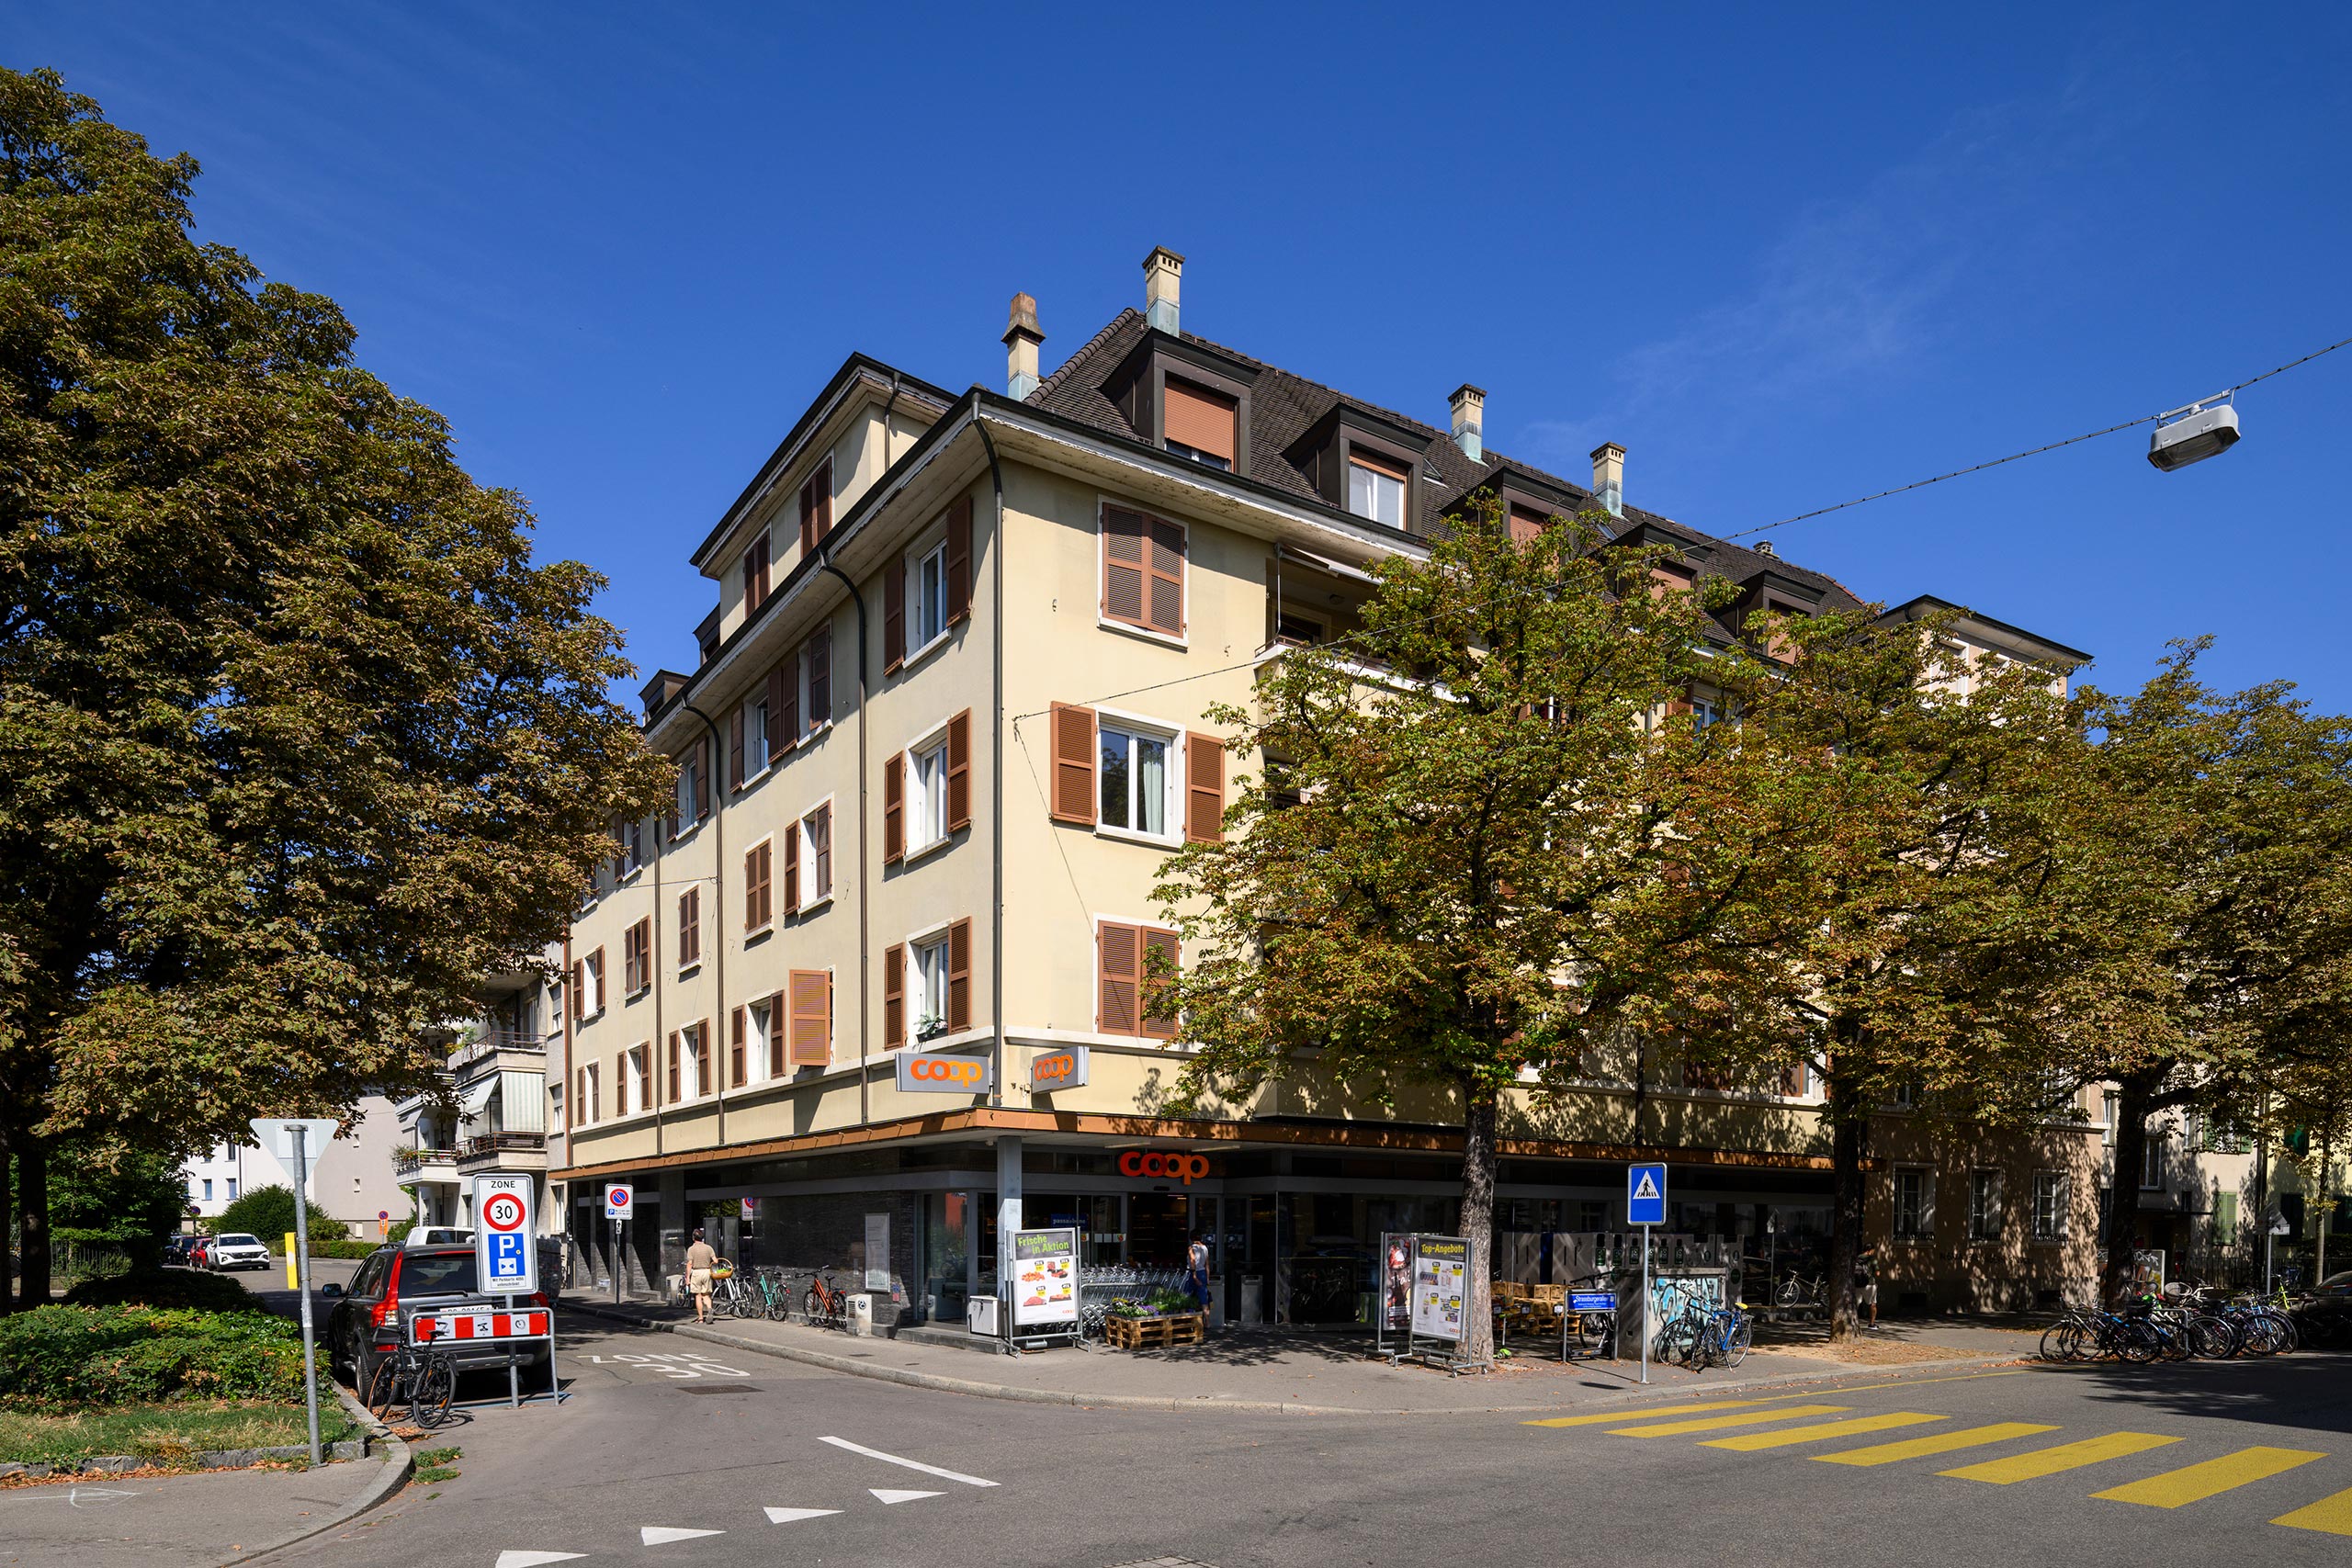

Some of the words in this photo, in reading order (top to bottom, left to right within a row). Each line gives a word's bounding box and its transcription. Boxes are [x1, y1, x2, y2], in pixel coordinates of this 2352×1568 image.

[910, 1059, 983, 1088] coop
[1035, 1055, 1073, 1082] coop
[1119, 1151, 1209, 1186] coop
[491, 1180, 515, 1189] ZONE
[495, 1205, 513, 1220] 30
[499, 1235, 514, 1258] P
[1017, 1235, 1047, 1247] Frische
[1032, 1245, 1041, 1255] in
[1042, 1241, 1069, 1253] Aktion
[1421, 1244, 1464, 1255] Top-Angebote
[577, 1354, 722, 1364] ZONE
[631, 1363, 751, 1378] 30
